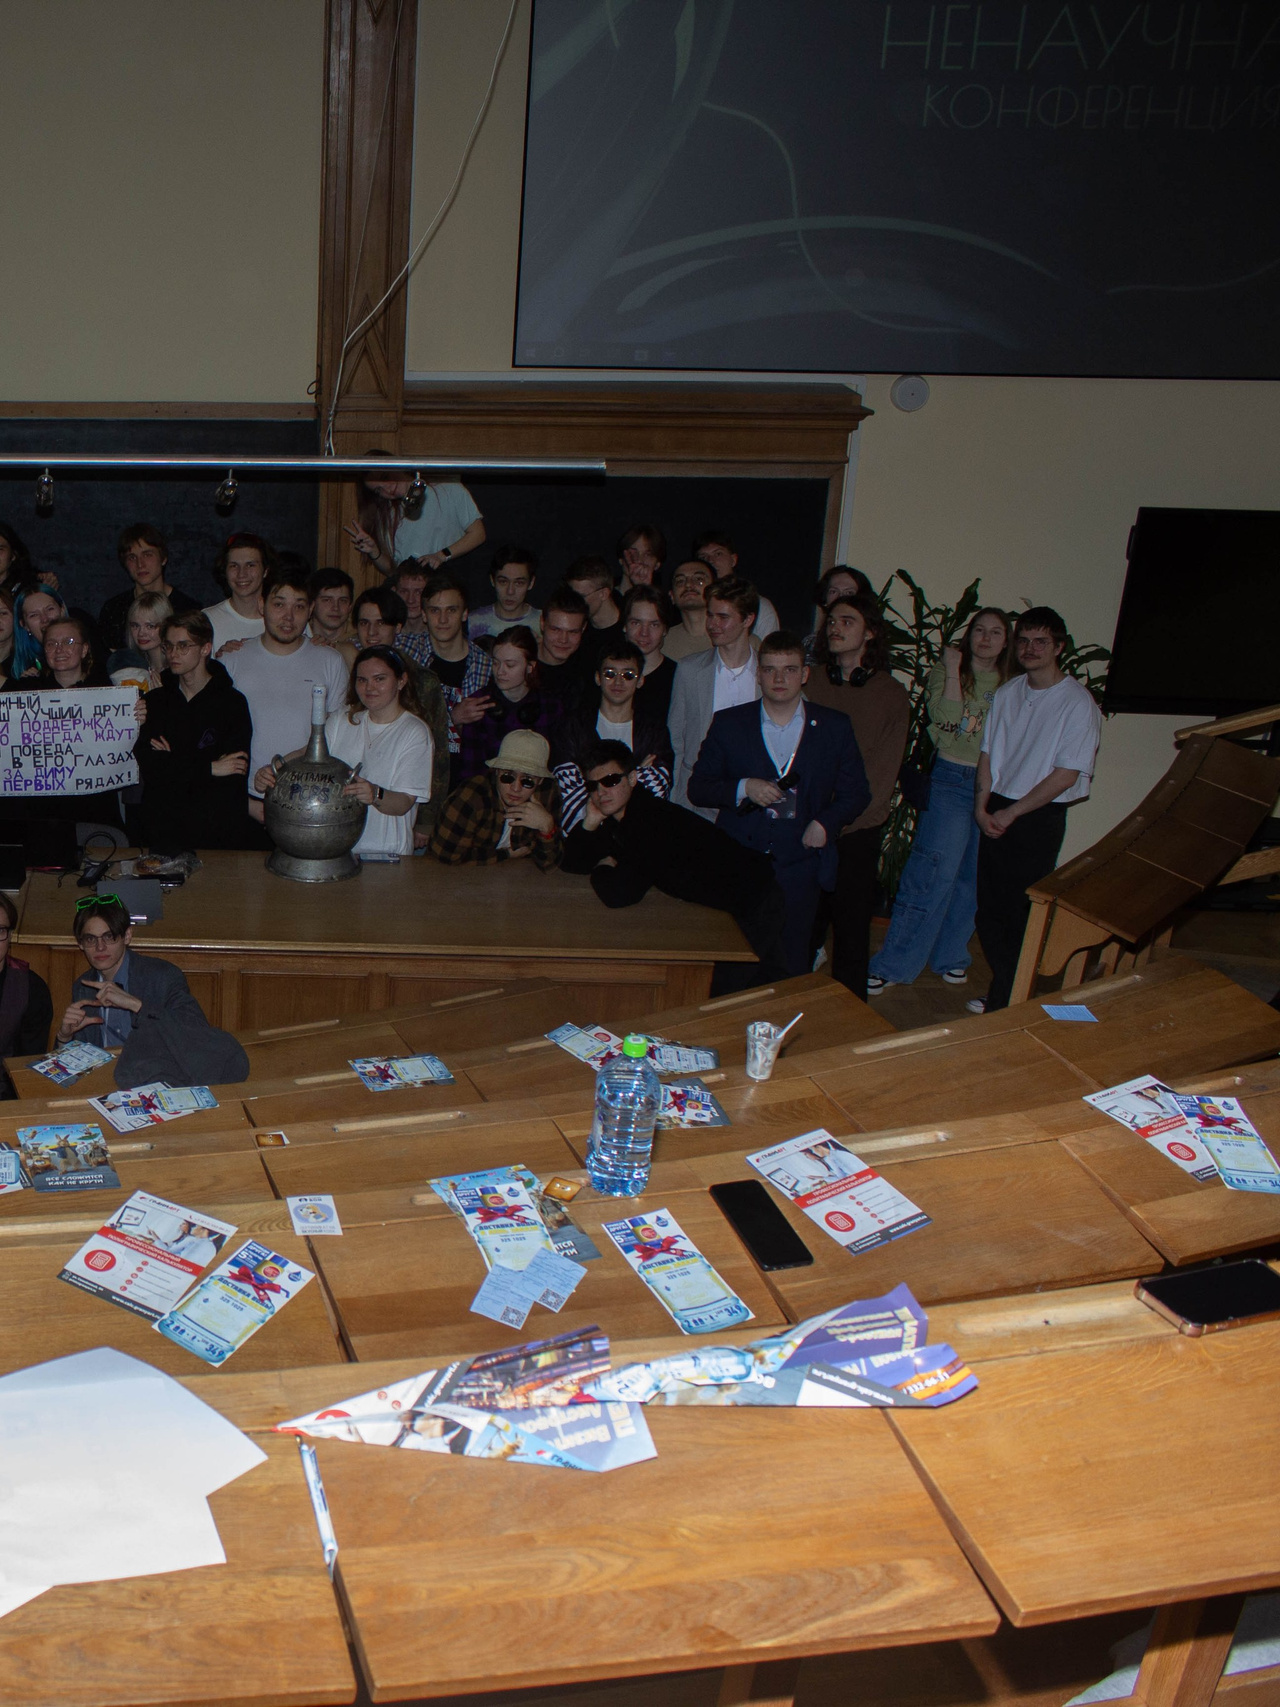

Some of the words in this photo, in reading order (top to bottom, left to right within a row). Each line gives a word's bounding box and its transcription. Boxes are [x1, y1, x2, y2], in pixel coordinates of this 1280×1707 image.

[922, 83, 1280, 133] КОНФЕРЕНЦИЯ
[21, 704, 83, 721] ЛУЧШИЙ
[21, 718, 114, 732] ПОДДЕРЖКА
[21, 731, 83, 744] ВСЕГДА
[11, 743, 74, 758] ПОБЕДА
[13, 757, 23, 769] В
[33, 756, 64, 768] ЕГО
[4, 769, 23, 780] ЗА
[35, 767, 75, 780] ДИМУ
[4, 779, 66, 792] ПЕРВЫХ
[76, 771, 131, 790] РЯДАХ!
[724, 1305, 742, 1317] 349
